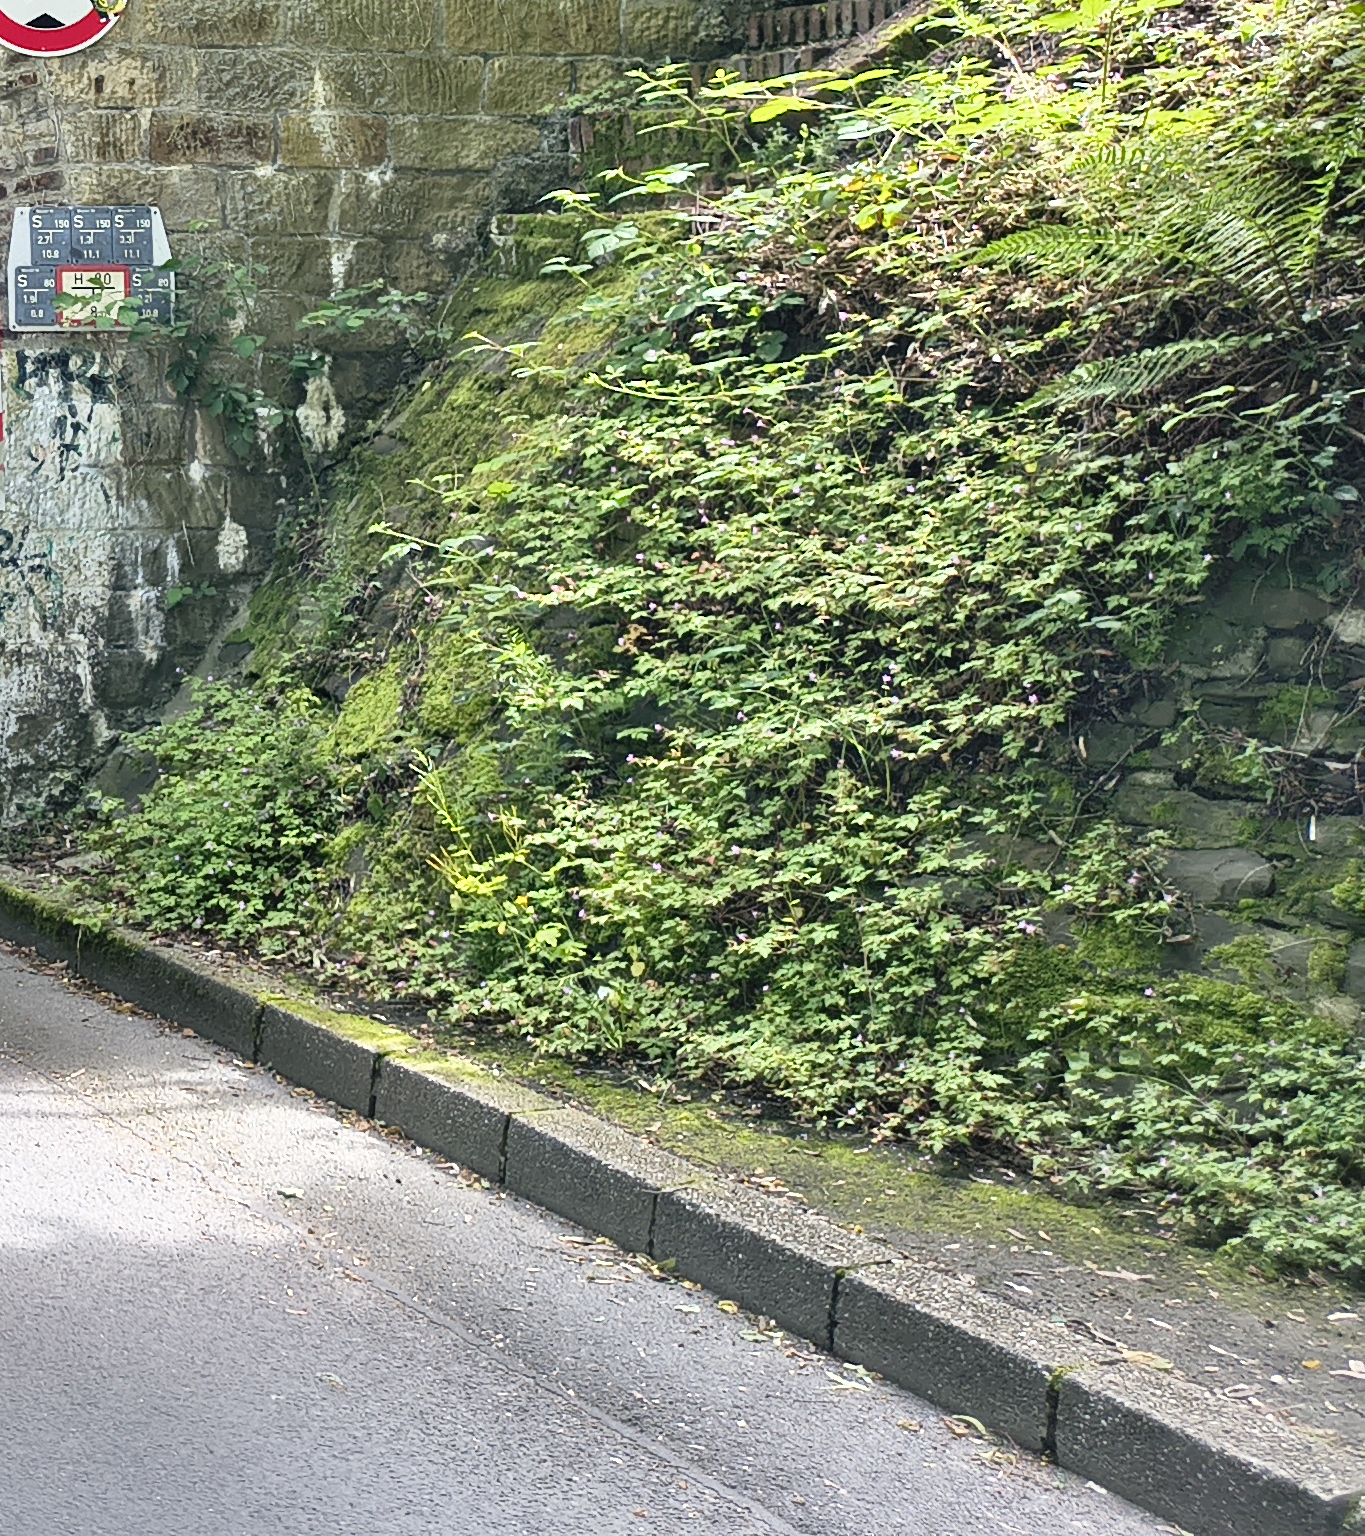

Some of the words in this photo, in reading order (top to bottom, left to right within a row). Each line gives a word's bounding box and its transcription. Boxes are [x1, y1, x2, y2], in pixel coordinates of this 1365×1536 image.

[32, 215, 43, 228] S
[54, 219, 70, 228] 150
[73, 215, 84, 228] S
[96, 219, 111, 228] 150
[114, 214, 125, 228] S
[136, 219, 151, 228] 150
[17, 274, 28, 288] S
[74, 273, 83, 285] H
[132, 273, 142, 287] S
